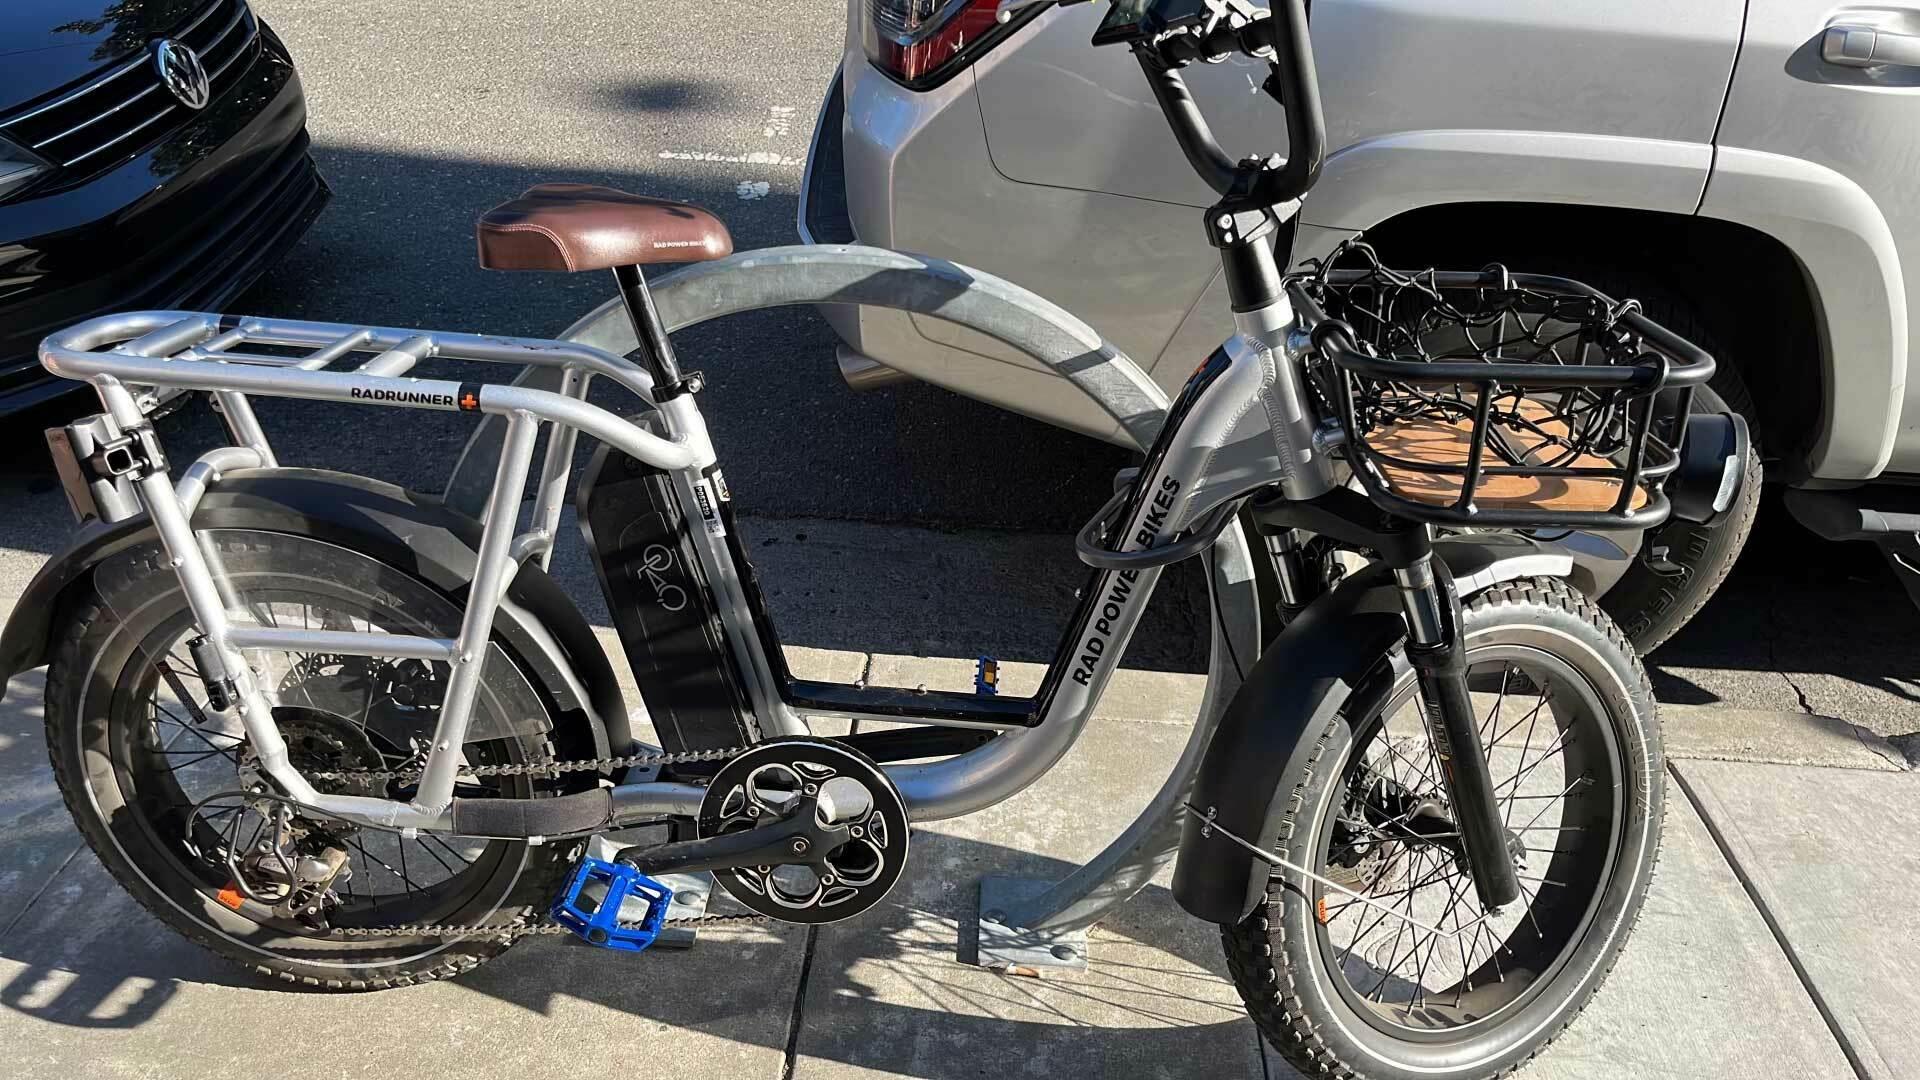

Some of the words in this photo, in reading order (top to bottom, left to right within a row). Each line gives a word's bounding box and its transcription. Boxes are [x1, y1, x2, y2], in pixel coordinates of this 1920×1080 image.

[351, 387, 455, 406] RADRUNNER
[1072, 637, 1105, 686] RAD
[1095, 568, 1140, 637] POWE
[1136, 475, 1181, 550] BIKES
